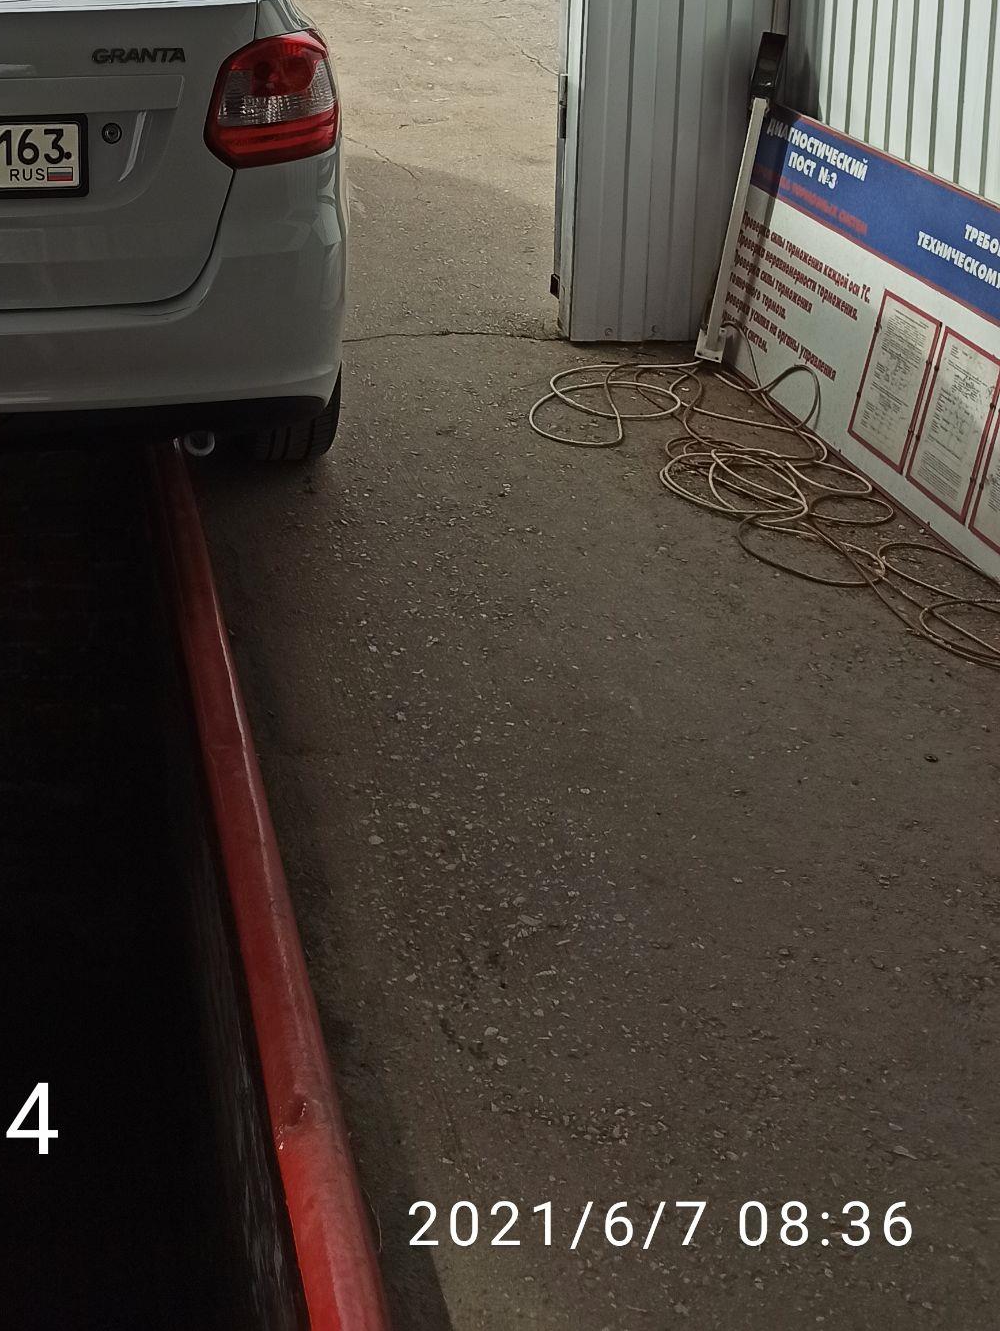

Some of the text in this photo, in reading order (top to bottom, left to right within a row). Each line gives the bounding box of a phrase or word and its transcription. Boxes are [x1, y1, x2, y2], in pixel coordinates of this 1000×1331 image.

[92, 47, 186, 64] GRANTA
[766, 118, 868, 182] ДИАГНОСТИЧЕСКИЙ
[9, 168, 45, 182] RUS
[788, 151, 817, 178] ПОСТ
[818, 166, 838, 190] №3
[770, 231, 786, 248] силы
[785, 240, 823, 274] торможения
[823, 264, 850, 290] каждой
[848, 280, 861, 297] оси
[775, 277, 813, 314] торможения
[799, 344, 837, 381] управления
